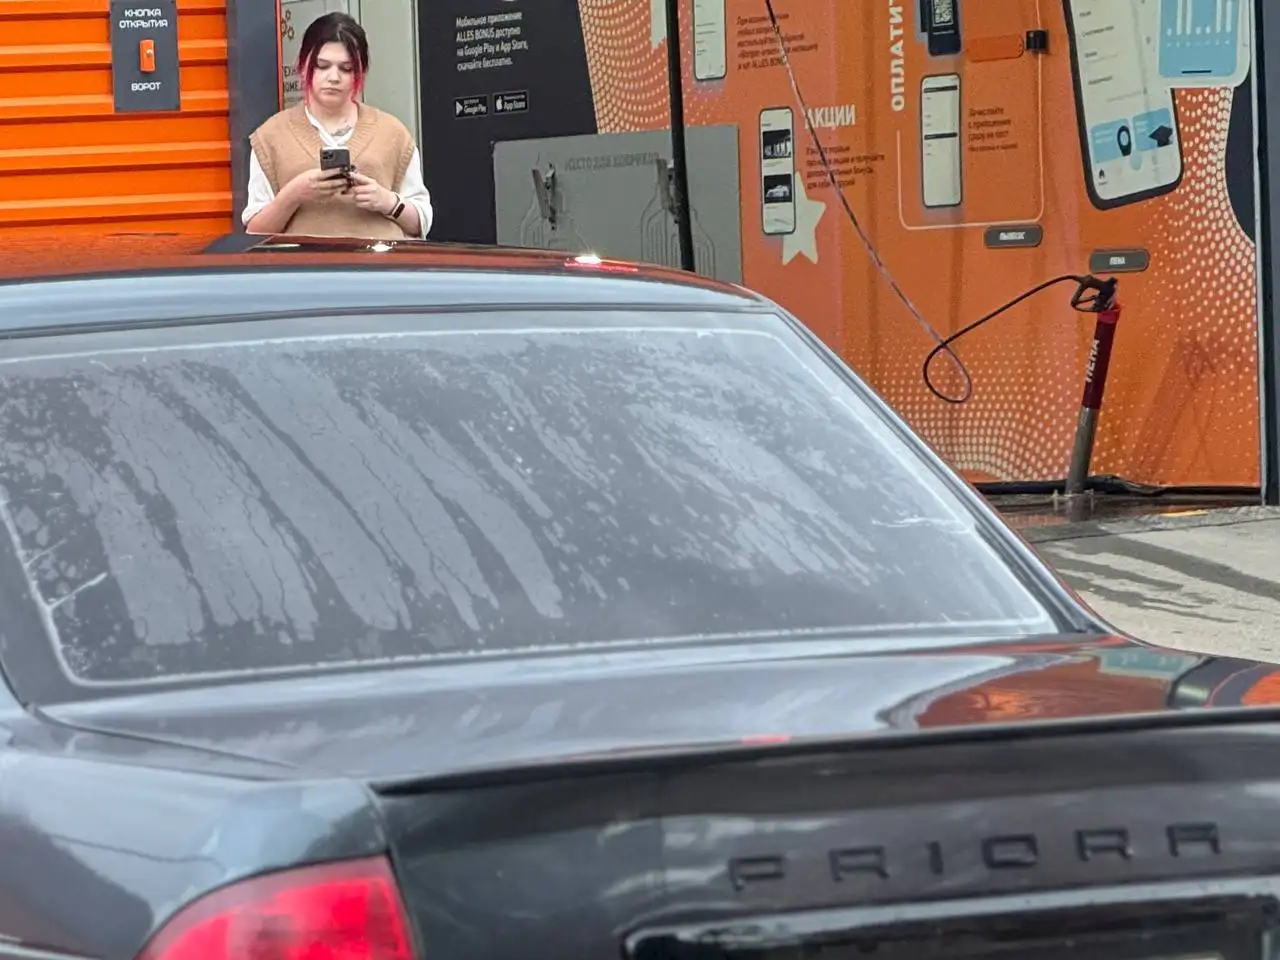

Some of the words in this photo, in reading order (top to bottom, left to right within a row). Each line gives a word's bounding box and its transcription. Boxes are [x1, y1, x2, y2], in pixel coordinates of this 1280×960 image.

[124, 8, 162, 17] КНОПКА
[119, 19, 168, 29] ОТКРЫТИЯ
[888, 0, 905, 112] ОПЛАТИ
[131, 82, 161, 91] ВОРОТ
[805, 104, 856, 131] АКЦИИ
[728, 822, 1221, 893] PRIORA
